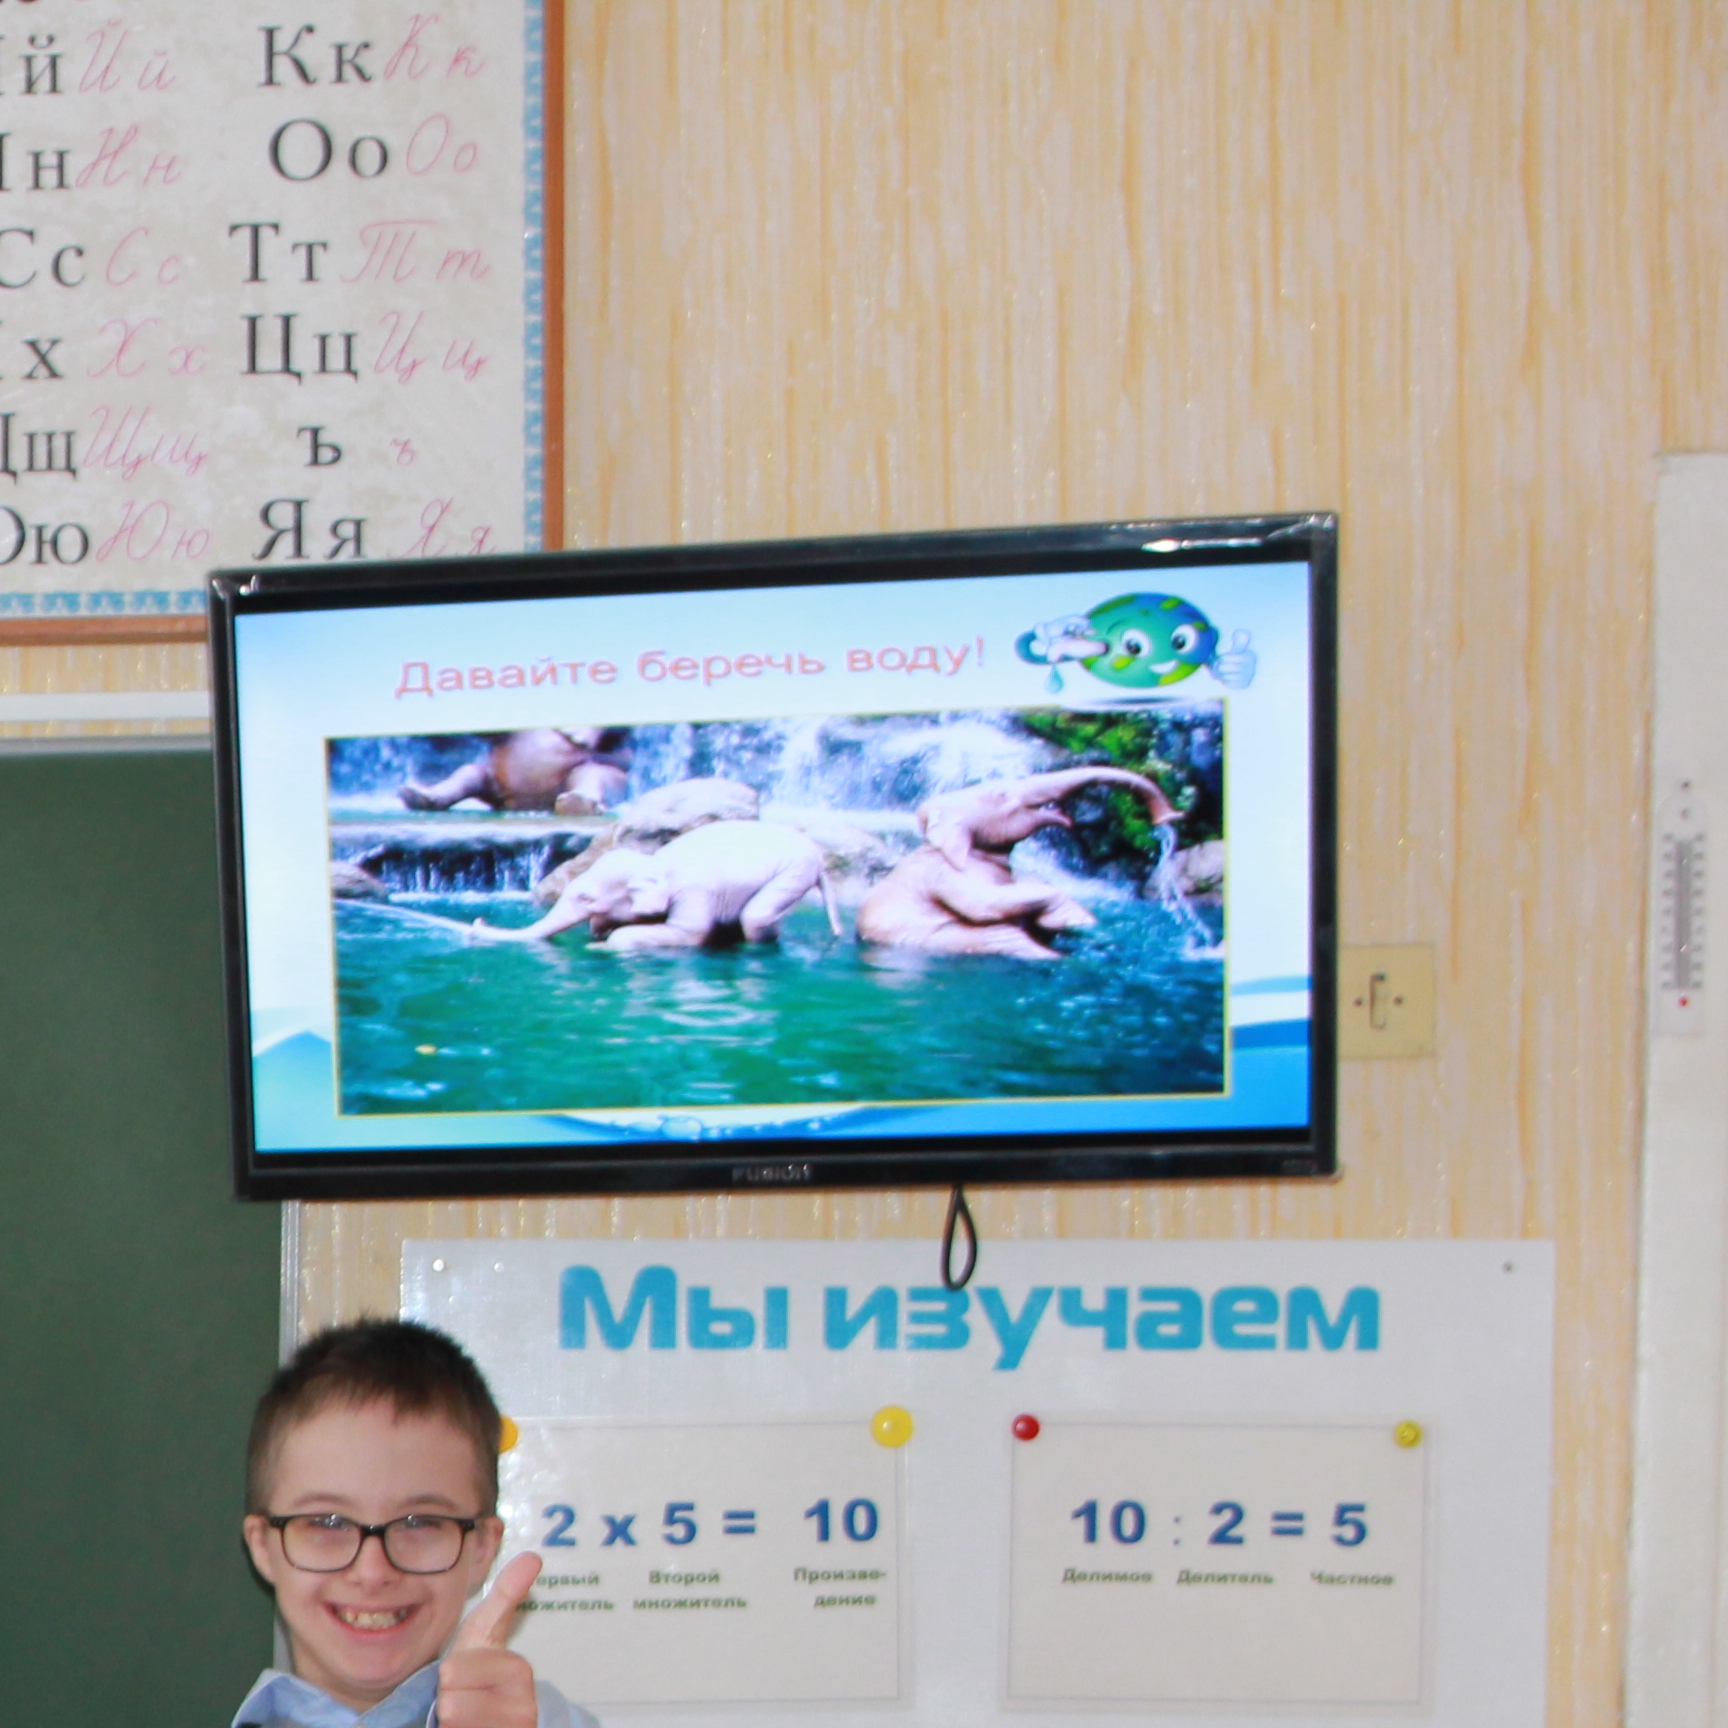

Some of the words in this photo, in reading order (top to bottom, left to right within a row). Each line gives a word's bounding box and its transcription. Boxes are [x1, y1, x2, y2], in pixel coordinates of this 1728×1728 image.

[258, 23, 373, 88] Кк
[269, 119, 388, 182] Оо
[229, 222, 328, 283] Тт
[241, 313, 358, 385] Цц
[297, 426, 341, 467] ъ
[252, 498, 367, 561] Яя
[395, 657, 618, 697] Давайте
[637, 650, 825, 685] беречь
[848, 636, 984, 675] воду!
[557, 1264, 790, 1351] Мы
[824, 1284, 1379, 1370] изучаем
[542, 1504, 576, 1546] 2
[662, 1502, 696, 1545] 5
[804, 1499, 878, 1542] 10
[1072, 1499, 1146, 1544] 10
[1209, 1501, 1244, 1544] 2
[1332, 1502, 1366, 1546] 5
[535, 1572, 599, 1589] ервый
[649, 1570, 720, 1585] Второй
[1063, 1568, 1153, 1584] Делимое
[1177, 1570, 1275, 1585] Делитель
[1311, 1571, 1393, 1585] Частное
[633, 1597, 746, 1610] множитель
